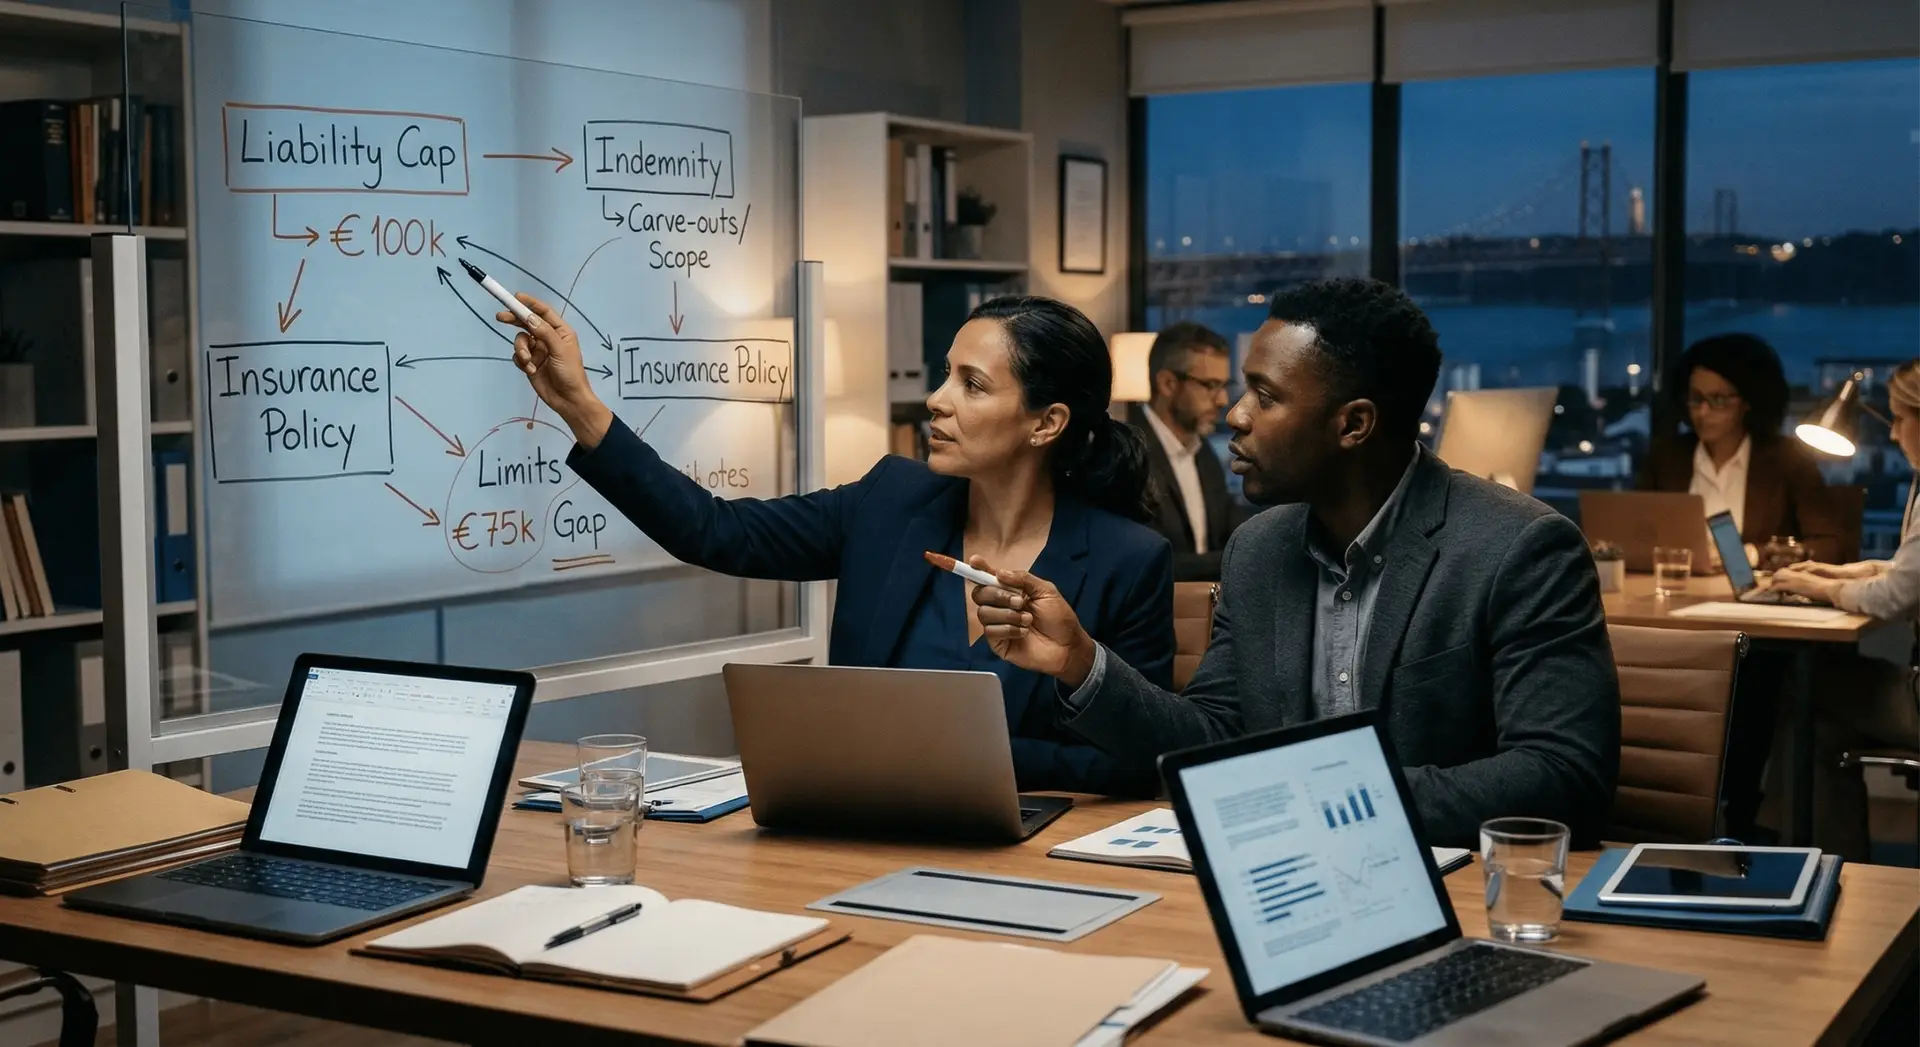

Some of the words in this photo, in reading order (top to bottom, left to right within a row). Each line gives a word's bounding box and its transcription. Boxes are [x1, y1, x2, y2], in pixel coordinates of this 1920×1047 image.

[241, 119, 383, 189] Liability
[397, 125, 456, 184] Cap
[595, 136, 722, 200] Indemnity
[628, 202, 751, 245] Carve-outs/
[649, 240, 711, 278] Scope
[216, 355, 380, 397] Insurance
[624, 346, 730, 385] Insurance
[734, 345, 789, 404] Policy
[260, 407, 356, 470] Policy
[478, 446, 562, 488] Limits
[452, 510, 536, 550] €75k
[553, 500, 607, 550] Gap
